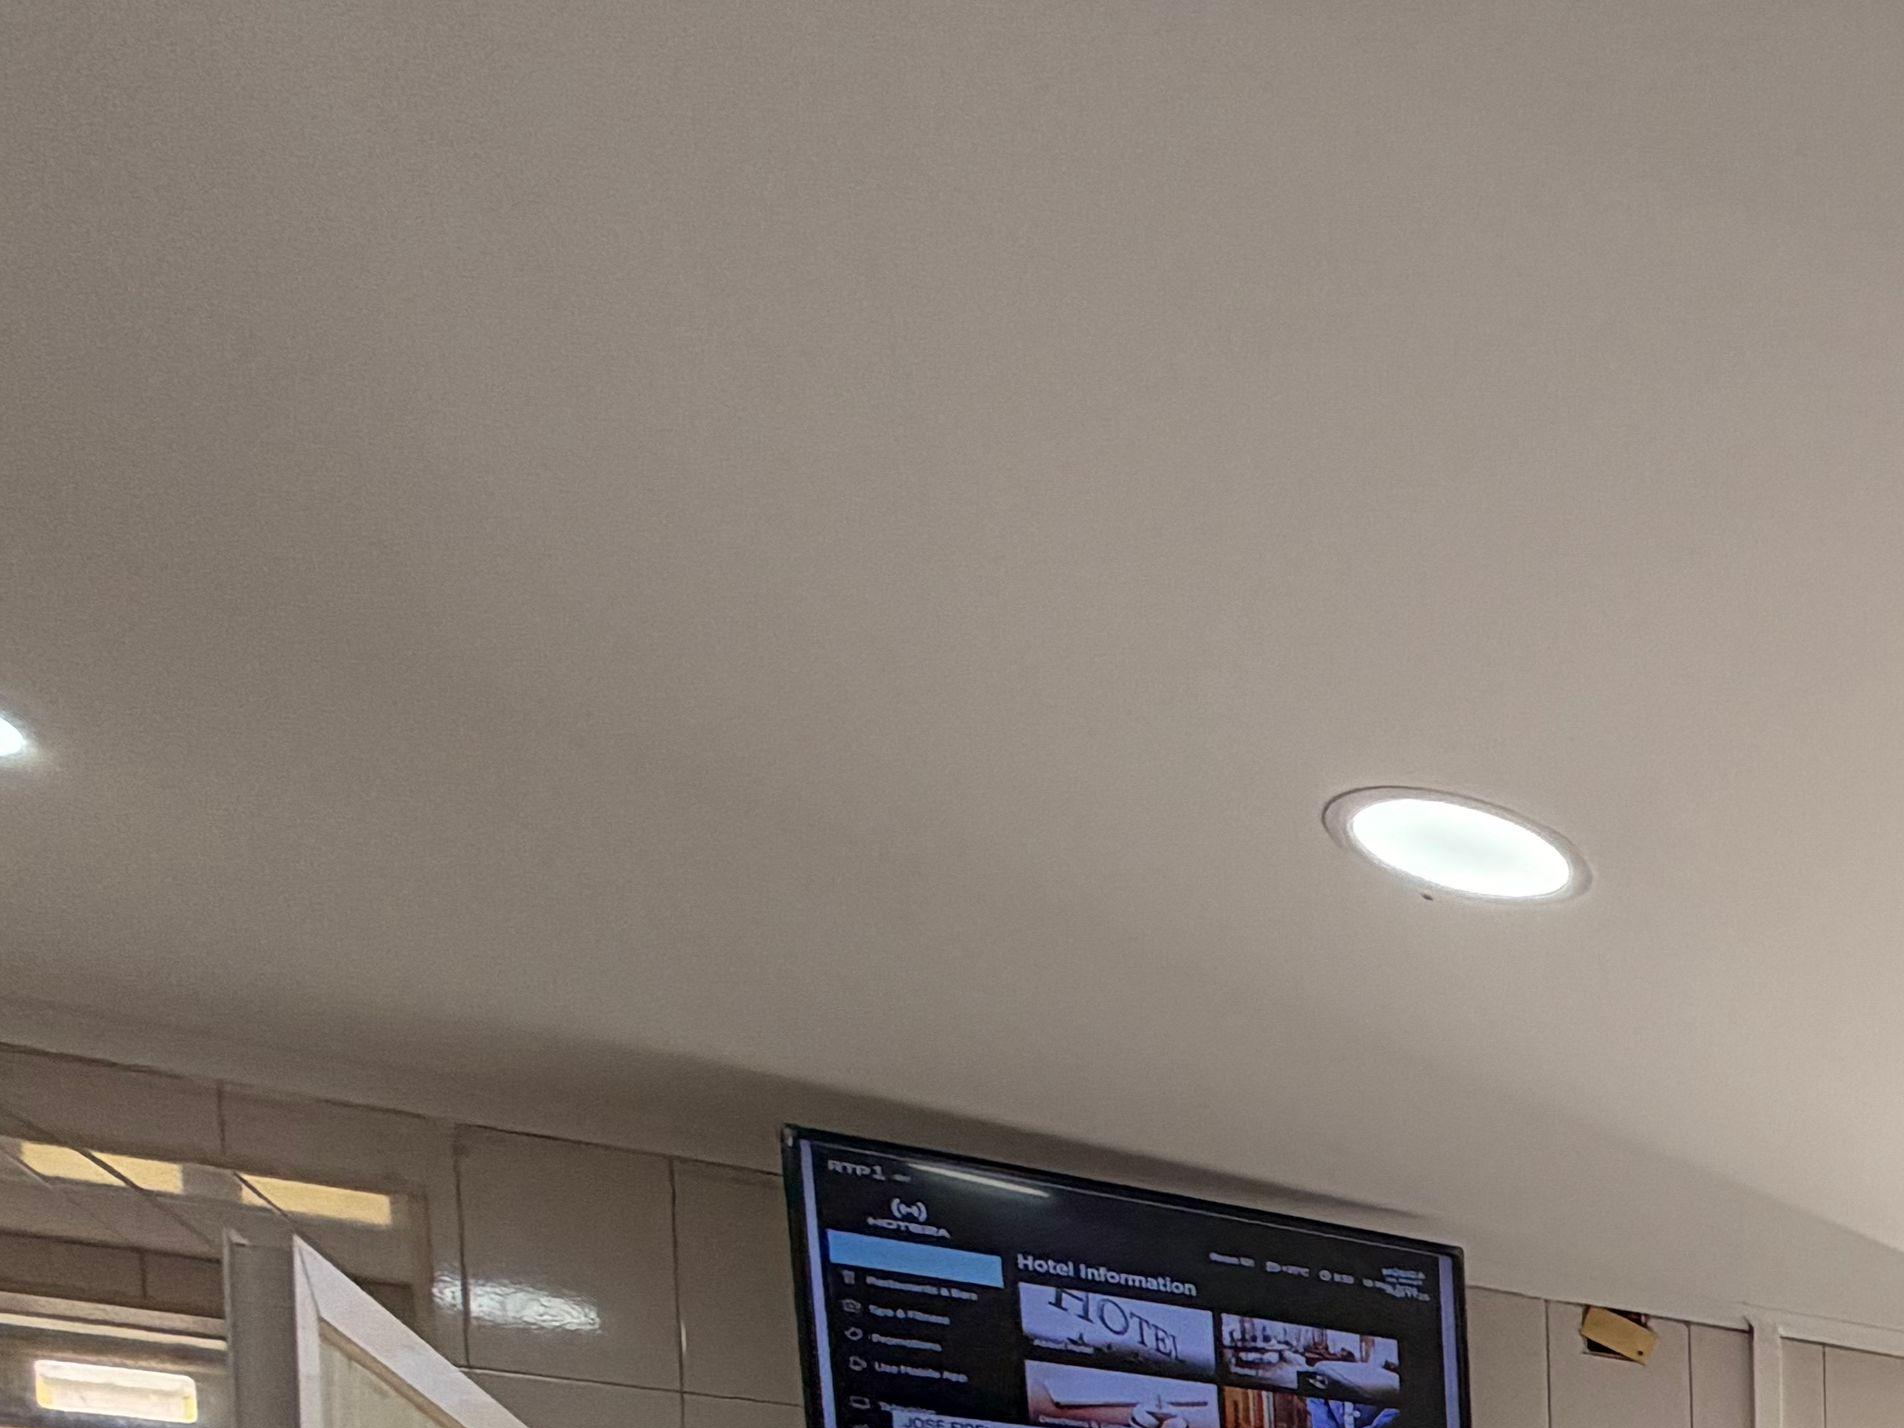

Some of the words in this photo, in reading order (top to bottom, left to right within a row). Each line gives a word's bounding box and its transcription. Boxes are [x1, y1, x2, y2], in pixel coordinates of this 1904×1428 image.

[1017, 1253, 1075, 1278] Hotel
[1080, 1263, 1198, 1297] Information
[1048, 1287, 1185, 1363] HOTEL
